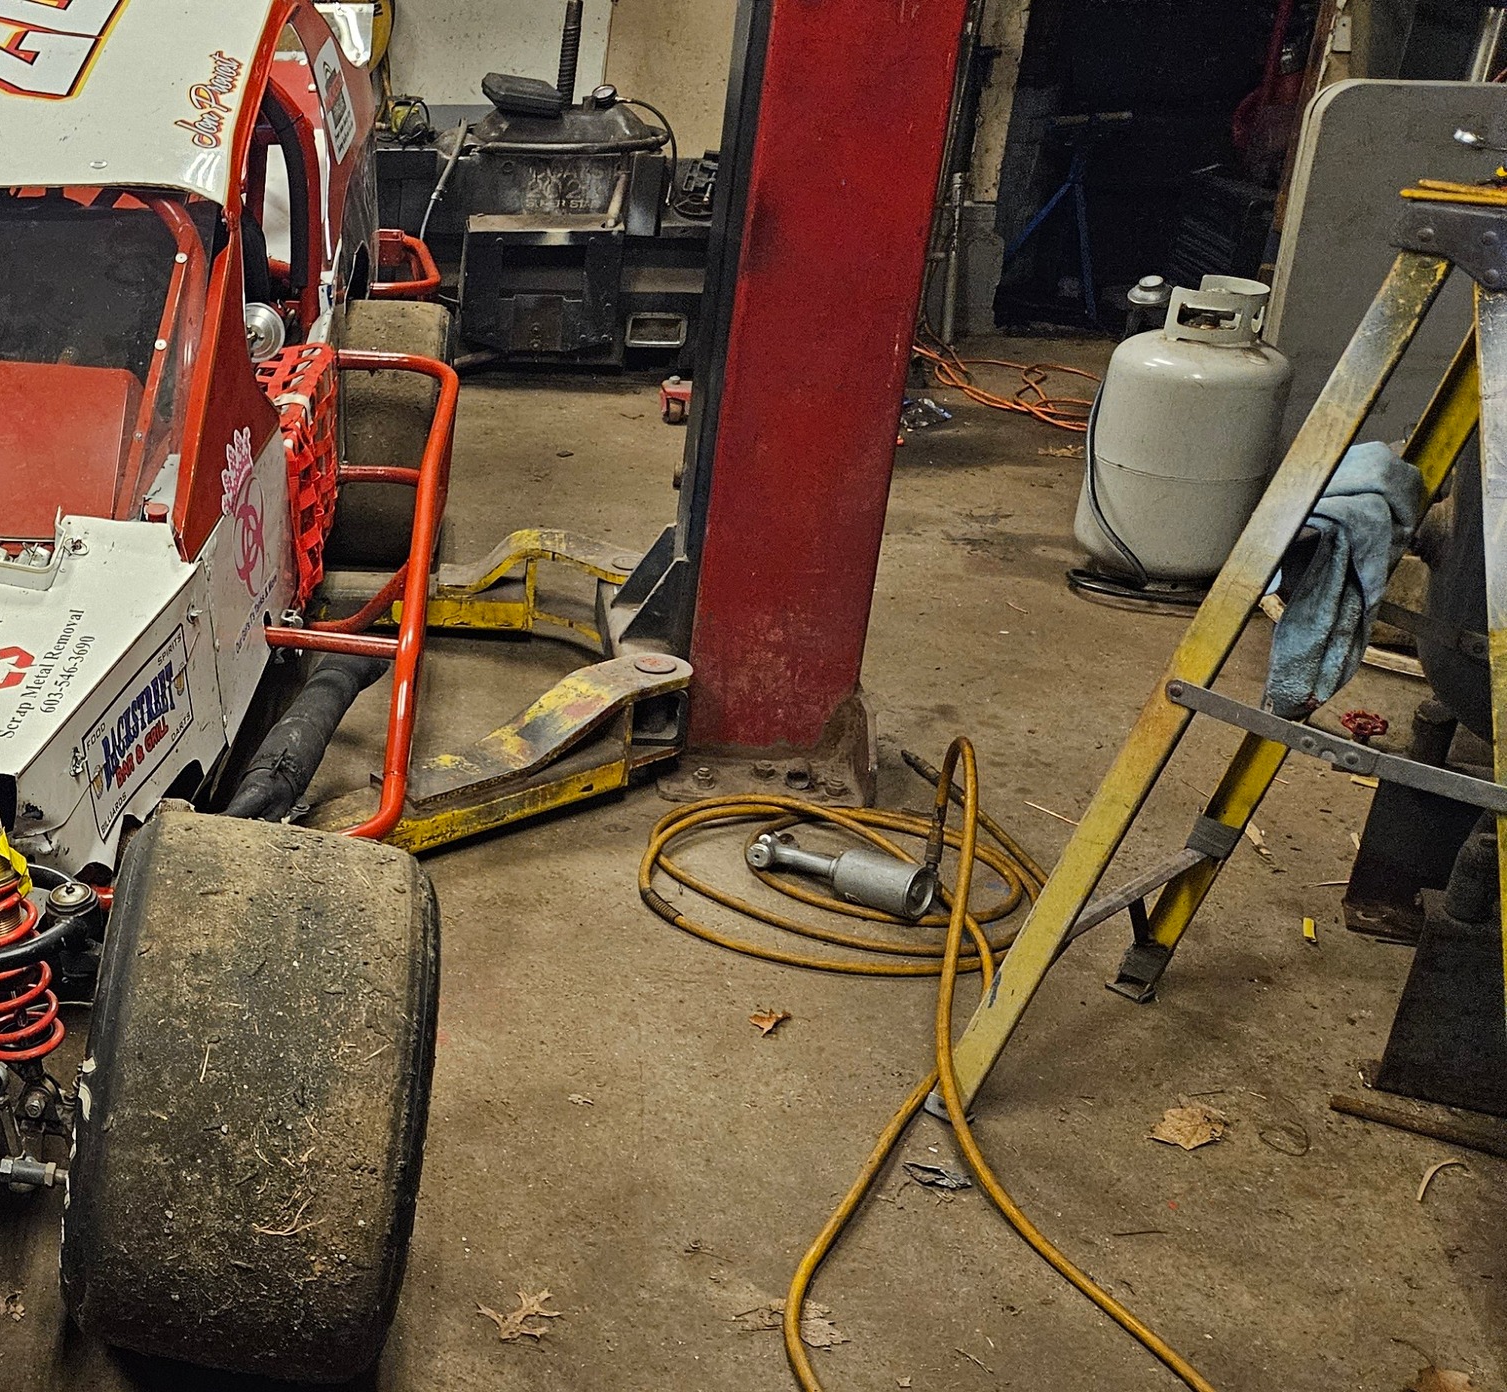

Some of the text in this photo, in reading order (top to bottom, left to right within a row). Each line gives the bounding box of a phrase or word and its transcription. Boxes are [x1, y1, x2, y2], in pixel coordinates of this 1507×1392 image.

[21, 663, 56, 699] Metal
[43, 609, 85, 661] Removal
[39, 635, 96, 714] 603-546-3690
[157, 632, 182, 667] SPIRITS
[85, 721, 107, 751] FOOD
[101, 659, 176, 793] BACKSTREET
[114, 715, 170, 790] BAR & GRILL
[170, 710, 192, 743] DARTS
[100, 790, 128, 834] BILLIARDS
